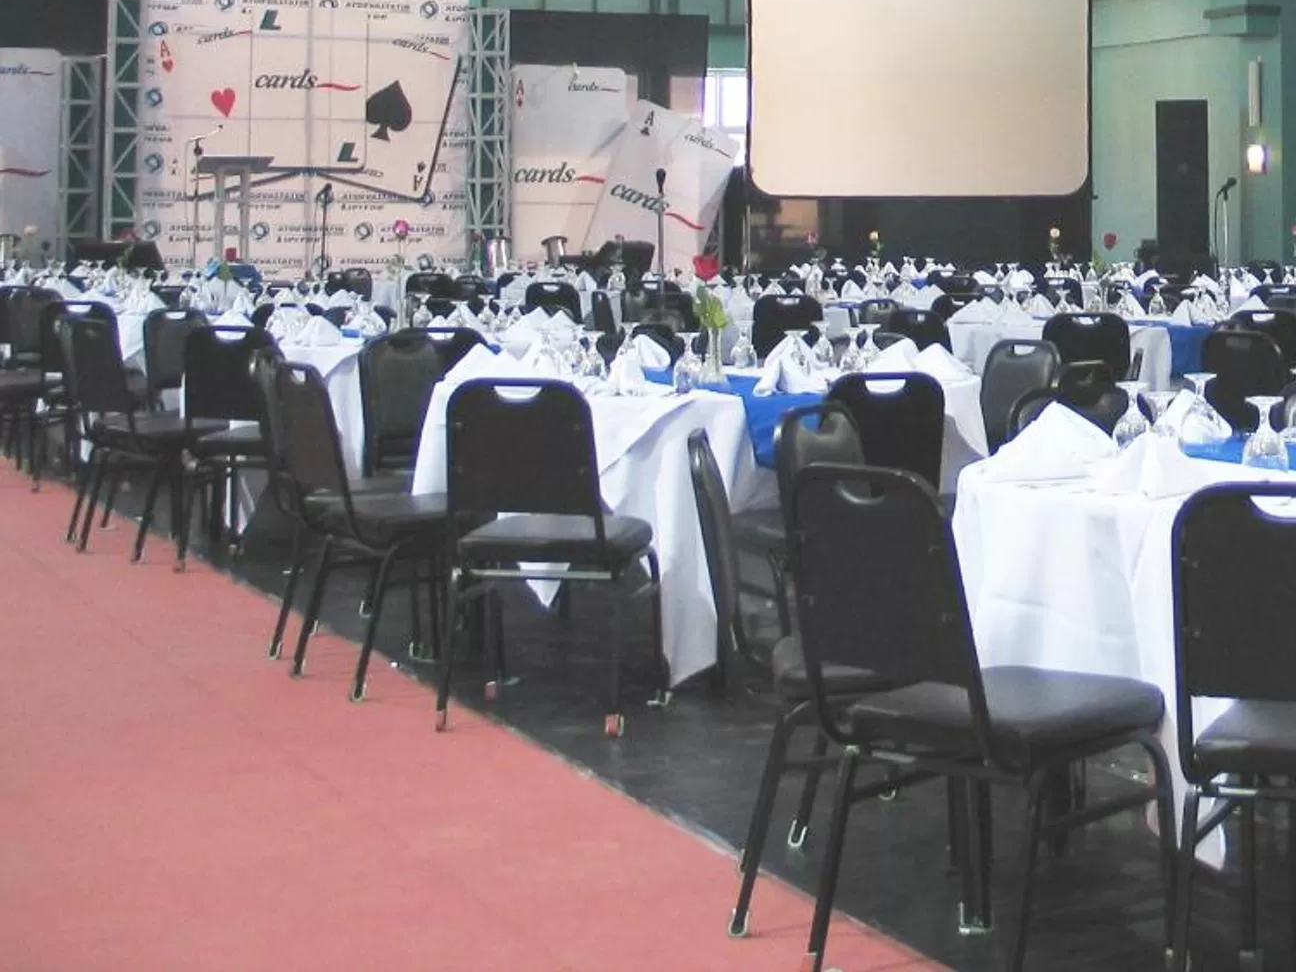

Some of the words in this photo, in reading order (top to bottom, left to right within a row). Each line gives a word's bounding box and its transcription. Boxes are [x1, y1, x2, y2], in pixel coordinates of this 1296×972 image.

[259, 9, 282, 31] L
[197, 27, 235, 45] cards
[391, 38, 430, 53] cards
[160, 39, 171, 58] A
[254, 67, 319, 90] cards
[644, 110, 656, 127] A
[336, 141, 359, 163] L
[514, 161, 577, 184] cards
[609, 182, 670, 215] cards
